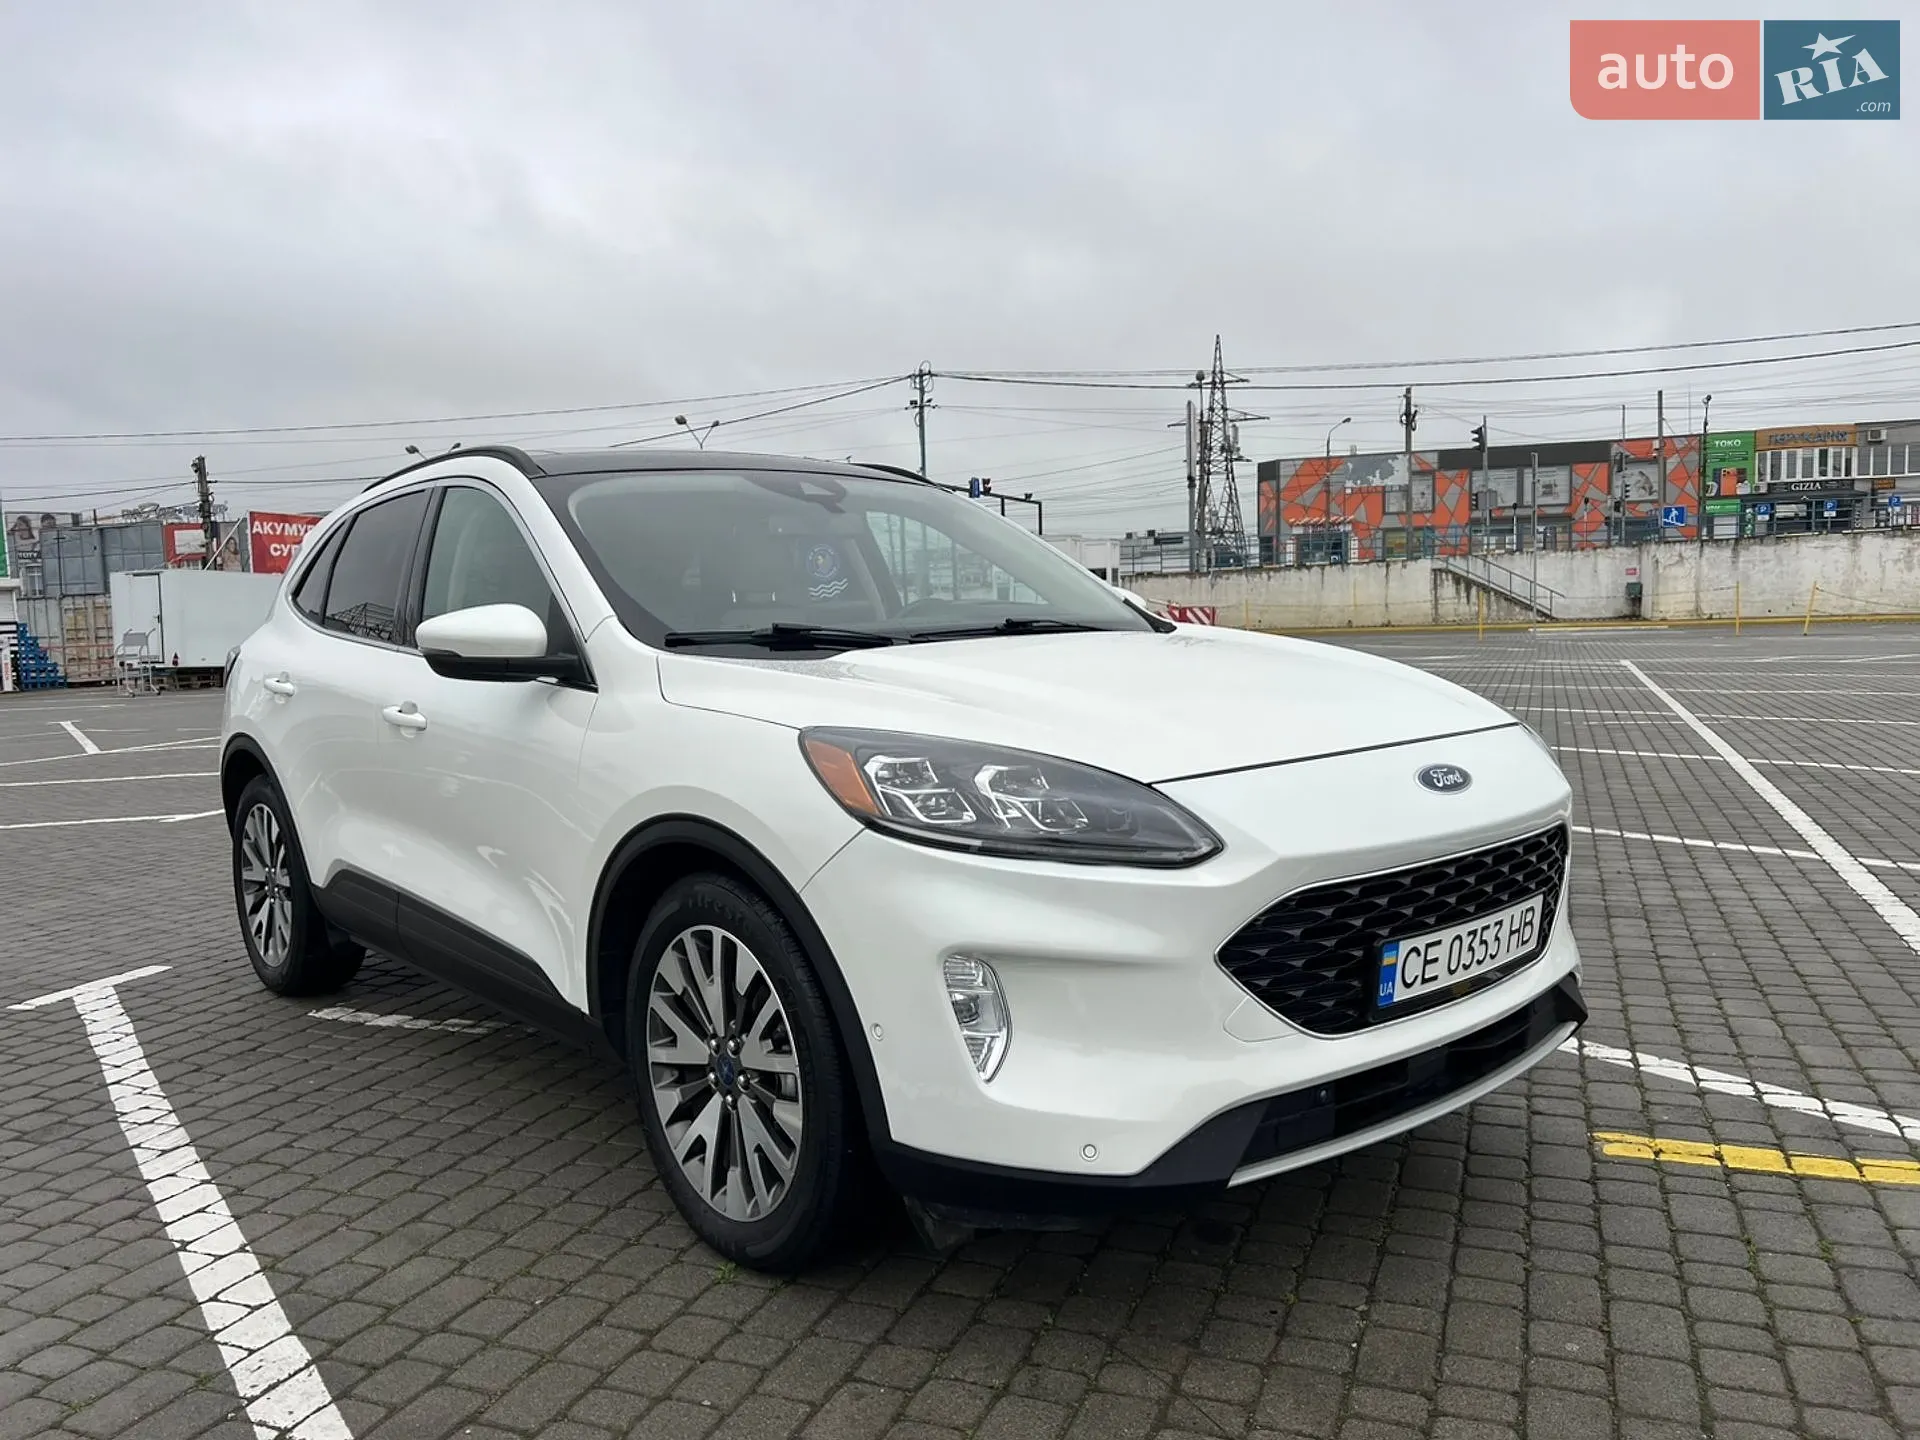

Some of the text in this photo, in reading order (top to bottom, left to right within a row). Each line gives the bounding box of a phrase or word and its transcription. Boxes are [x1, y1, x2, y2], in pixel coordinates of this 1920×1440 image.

[1791, 482, 1822, 491] GIZIA
[1430, 768, 1463, 787] Ford
[1401, 905, 1536, 989] CE 0353 HB
[1379, 981, 1394, 997] UA
